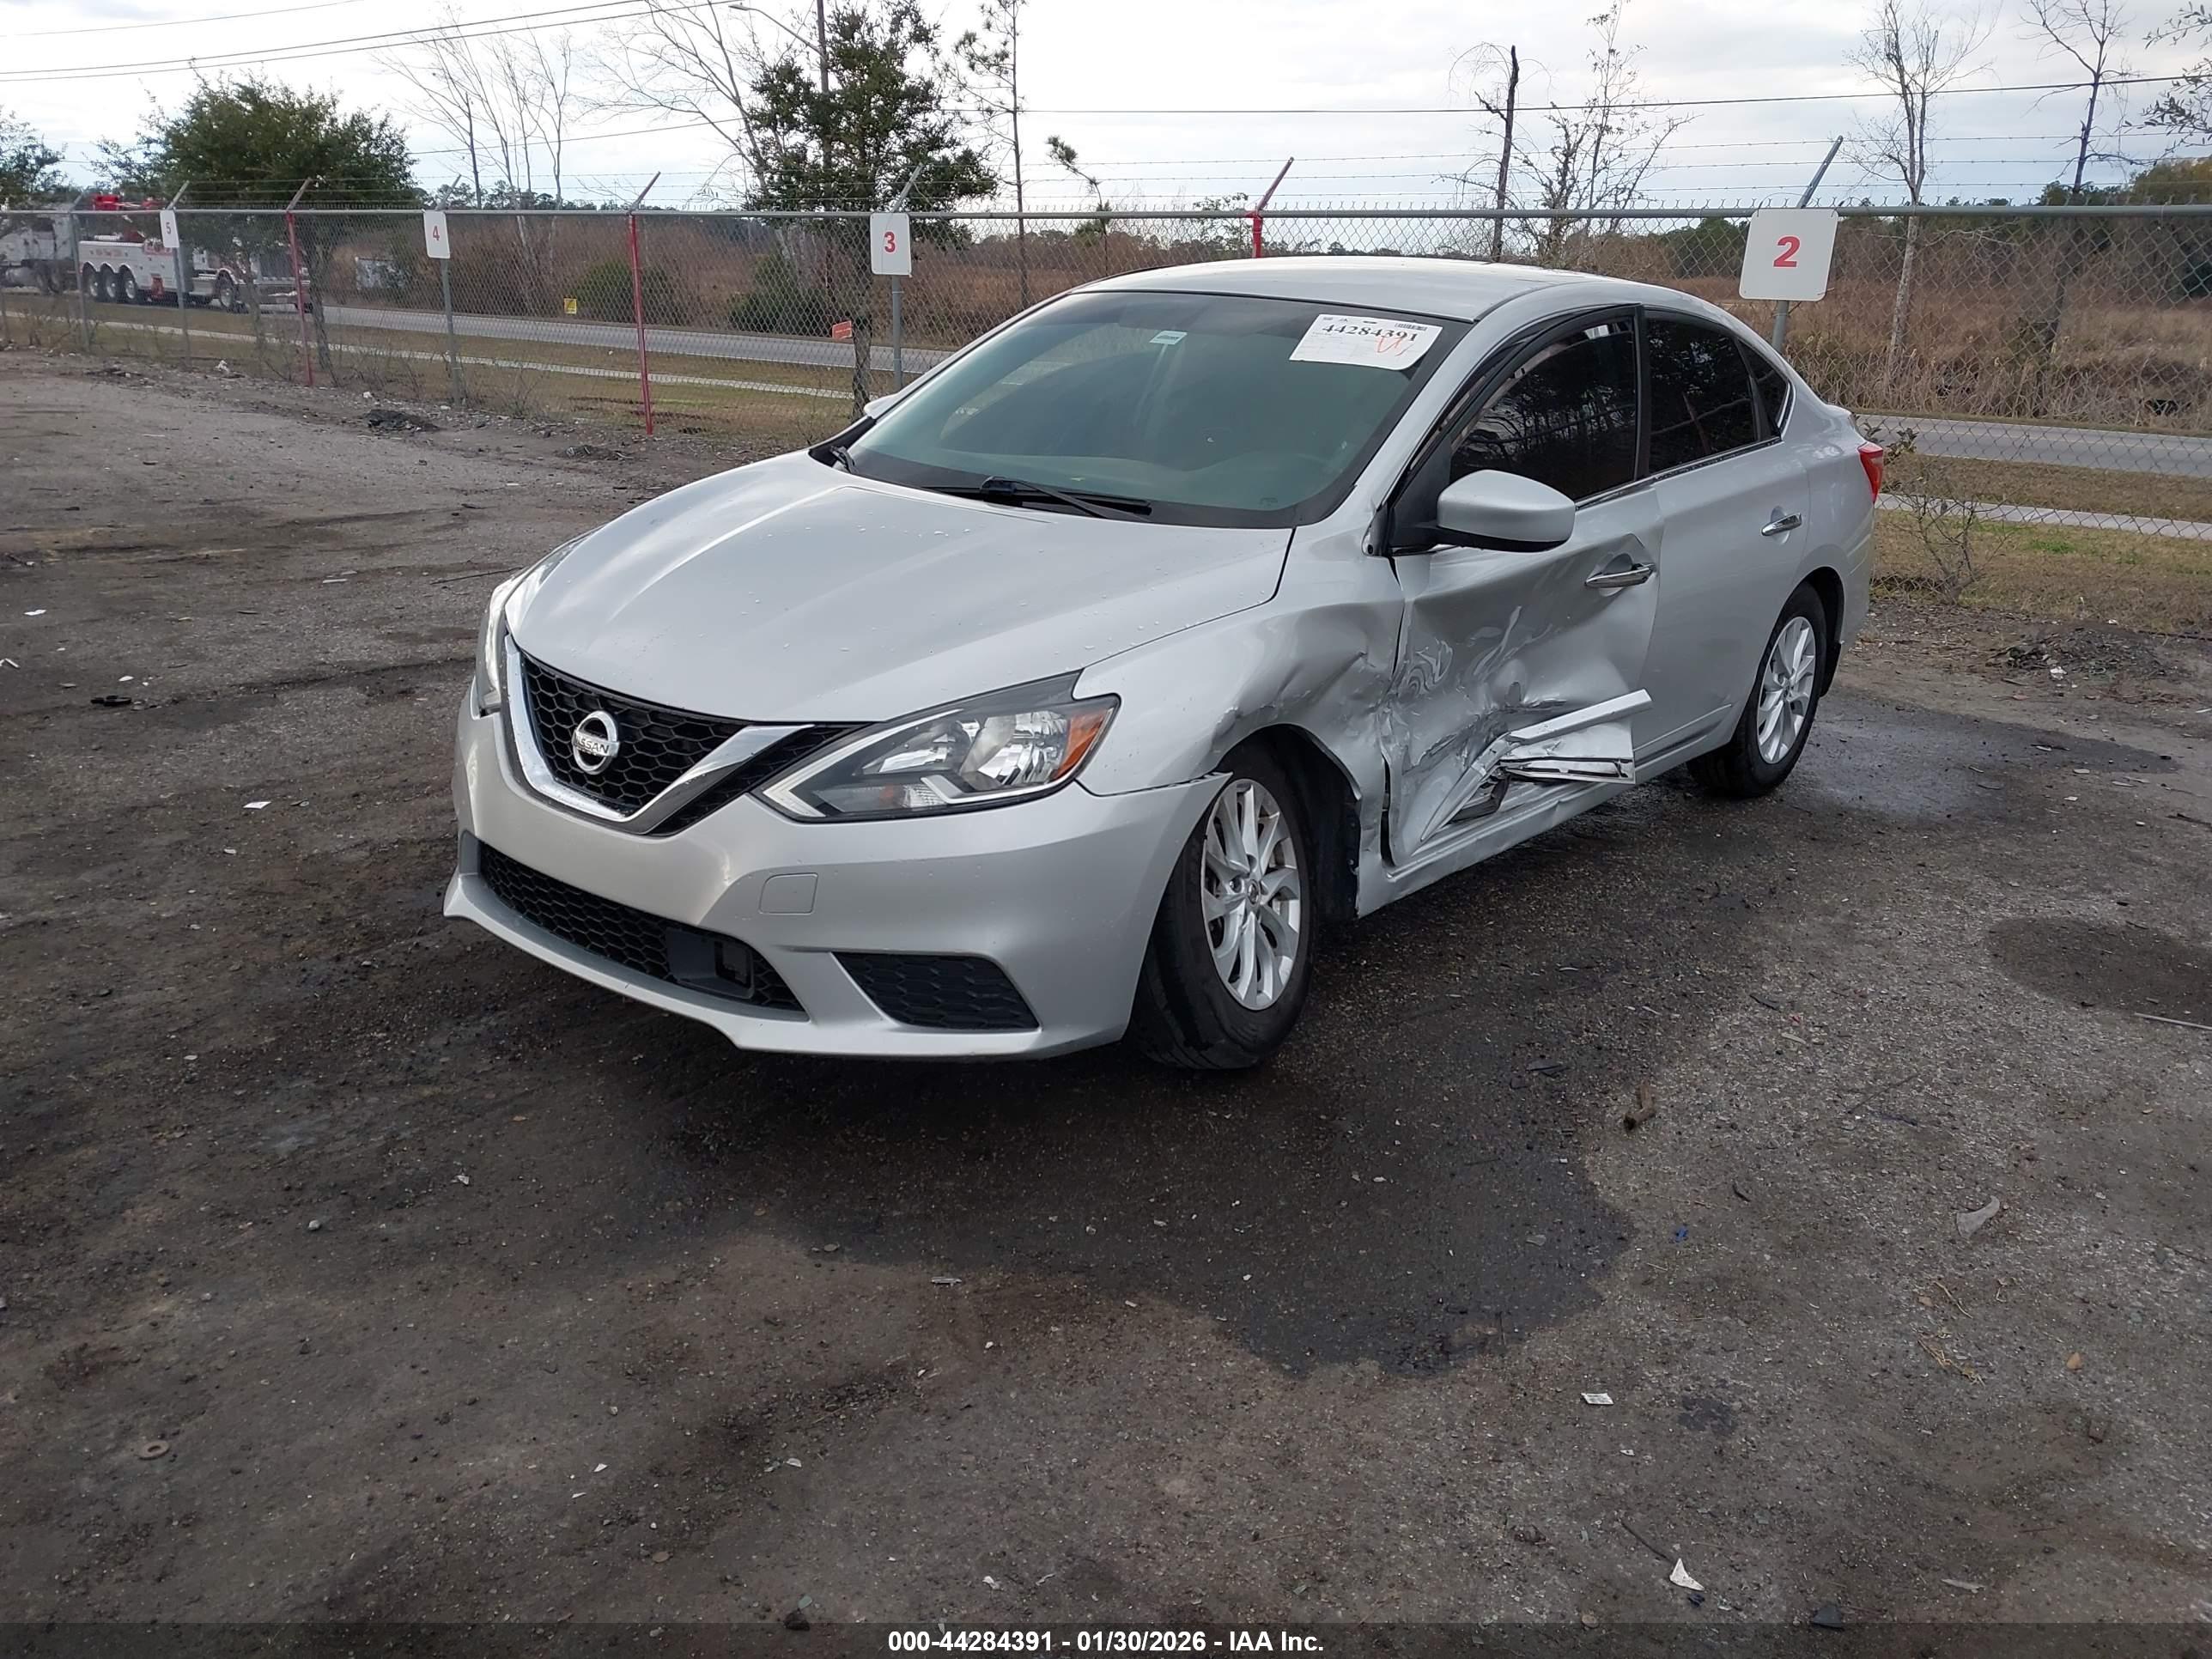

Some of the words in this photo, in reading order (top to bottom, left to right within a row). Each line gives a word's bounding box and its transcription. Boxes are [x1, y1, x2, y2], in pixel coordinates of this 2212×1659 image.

[166, 222, 172, 234] 5
[432, 225, 441, 241] 4
[884, 231, 896, 252] 3
[1772, 235, 1801, 268] 2
[1322, 324, 1418, 342] 44284391
[576, 735, 610, 754] SSAN
